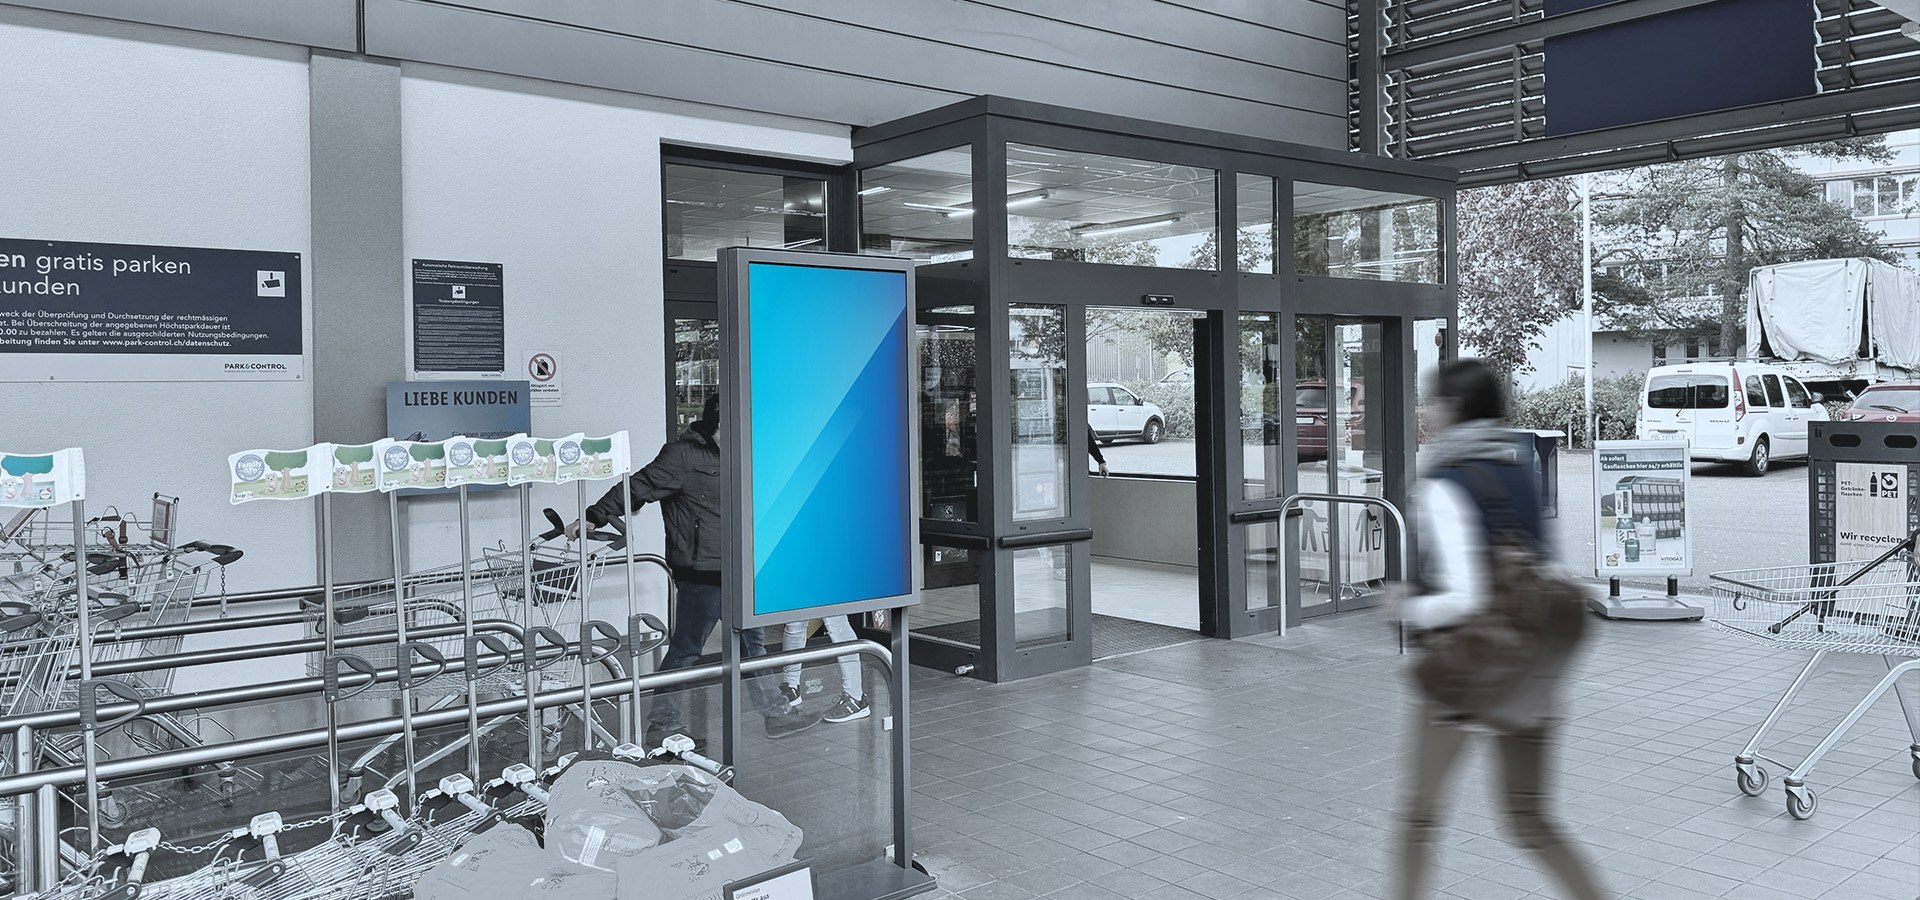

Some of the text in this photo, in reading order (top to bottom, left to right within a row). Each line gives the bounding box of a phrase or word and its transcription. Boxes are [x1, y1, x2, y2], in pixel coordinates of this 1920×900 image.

[0, 253, 191, 276] en gratis parken
[0, 276, 80, 296] unden
[22, 310, 36, 318] der
[38, 310, 89, 320] Überprüfung
[107, 312, 160, 321] Durchsetzung
[176, 314, 228, 323] rechtmässigen
[11, 319, 25, 327] Bei
[27, 318, 88, 328] Überschreitung
[105, 321, 158, 330] angegebenen
[159, 322, 221, 331] Höchstparkdauer
[82, 329, 107, 338] gelten
[123, 330, 186, 339] ausgeschilderten
[188, 331, 270, 340] Nutzungsbedingungen.
[102, 339, 232, 347] www.park-control.ch/datenschutz.
[404, 391, 449, 406] LIEBE
[453, 390, 518, 406] KUNDEN
[1840, 532, 1858, 540] Wir
